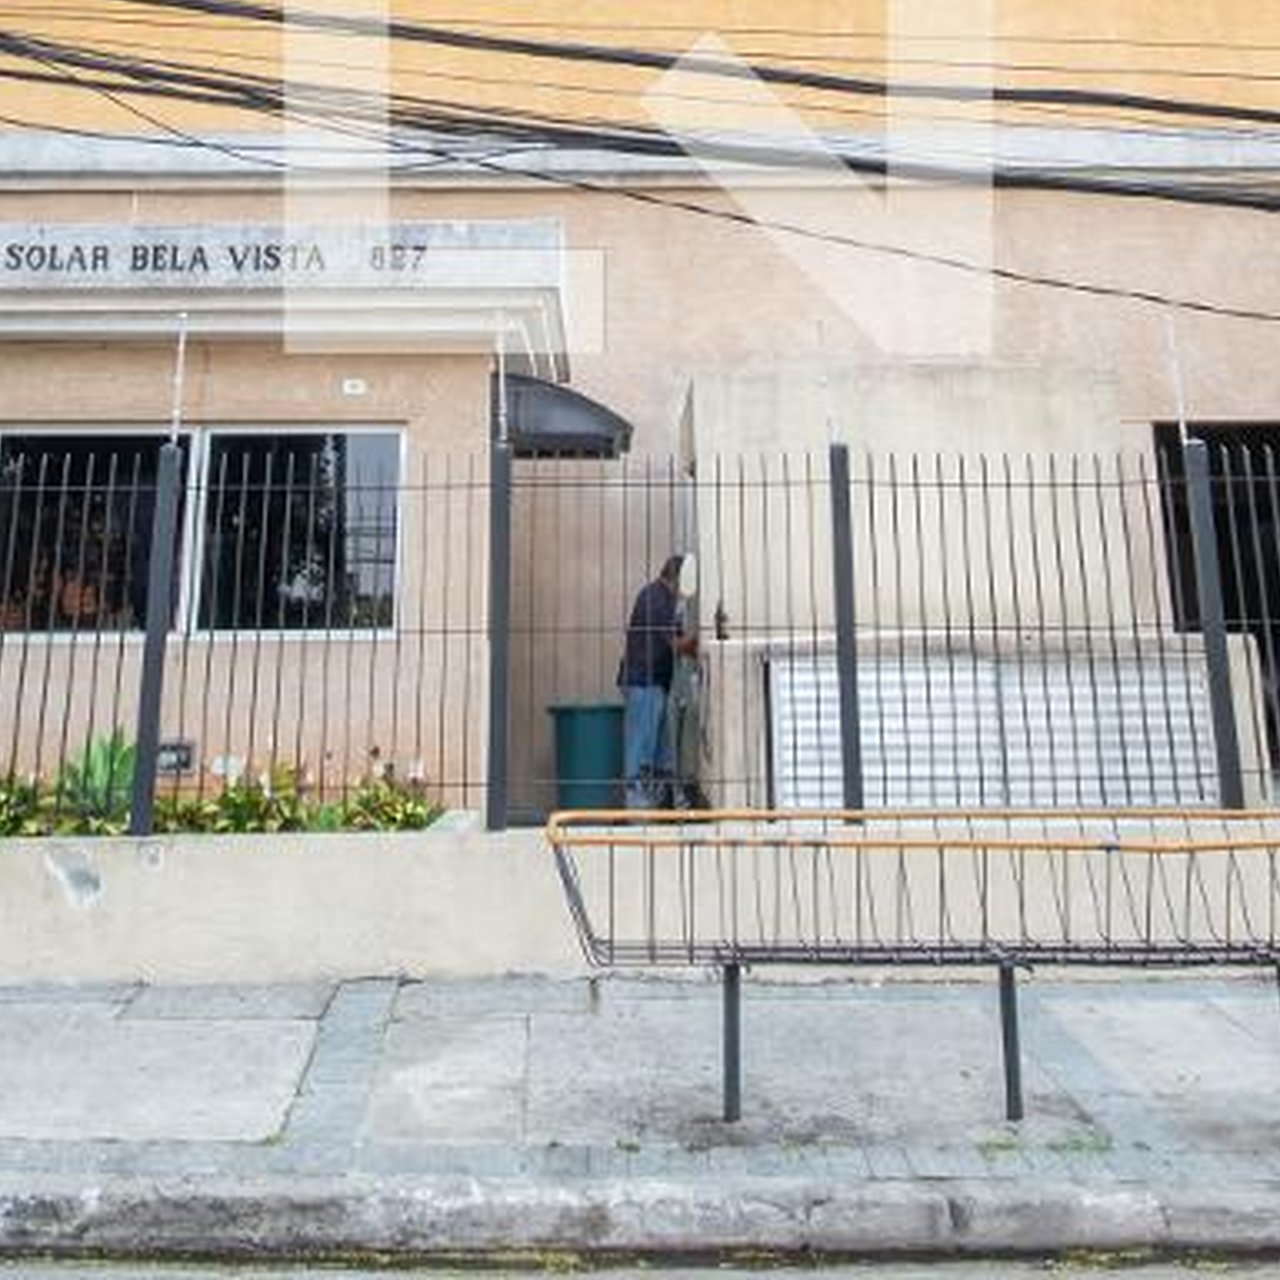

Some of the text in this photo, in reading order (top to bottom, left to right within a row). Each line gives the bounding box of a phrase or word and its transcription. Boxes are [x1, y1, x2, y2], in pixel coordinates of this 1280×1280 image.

[4, 242, 109, 271] SOLAR
[129, 243, 209, 271] BELA
[228, 243, 326, 271] VISTA
